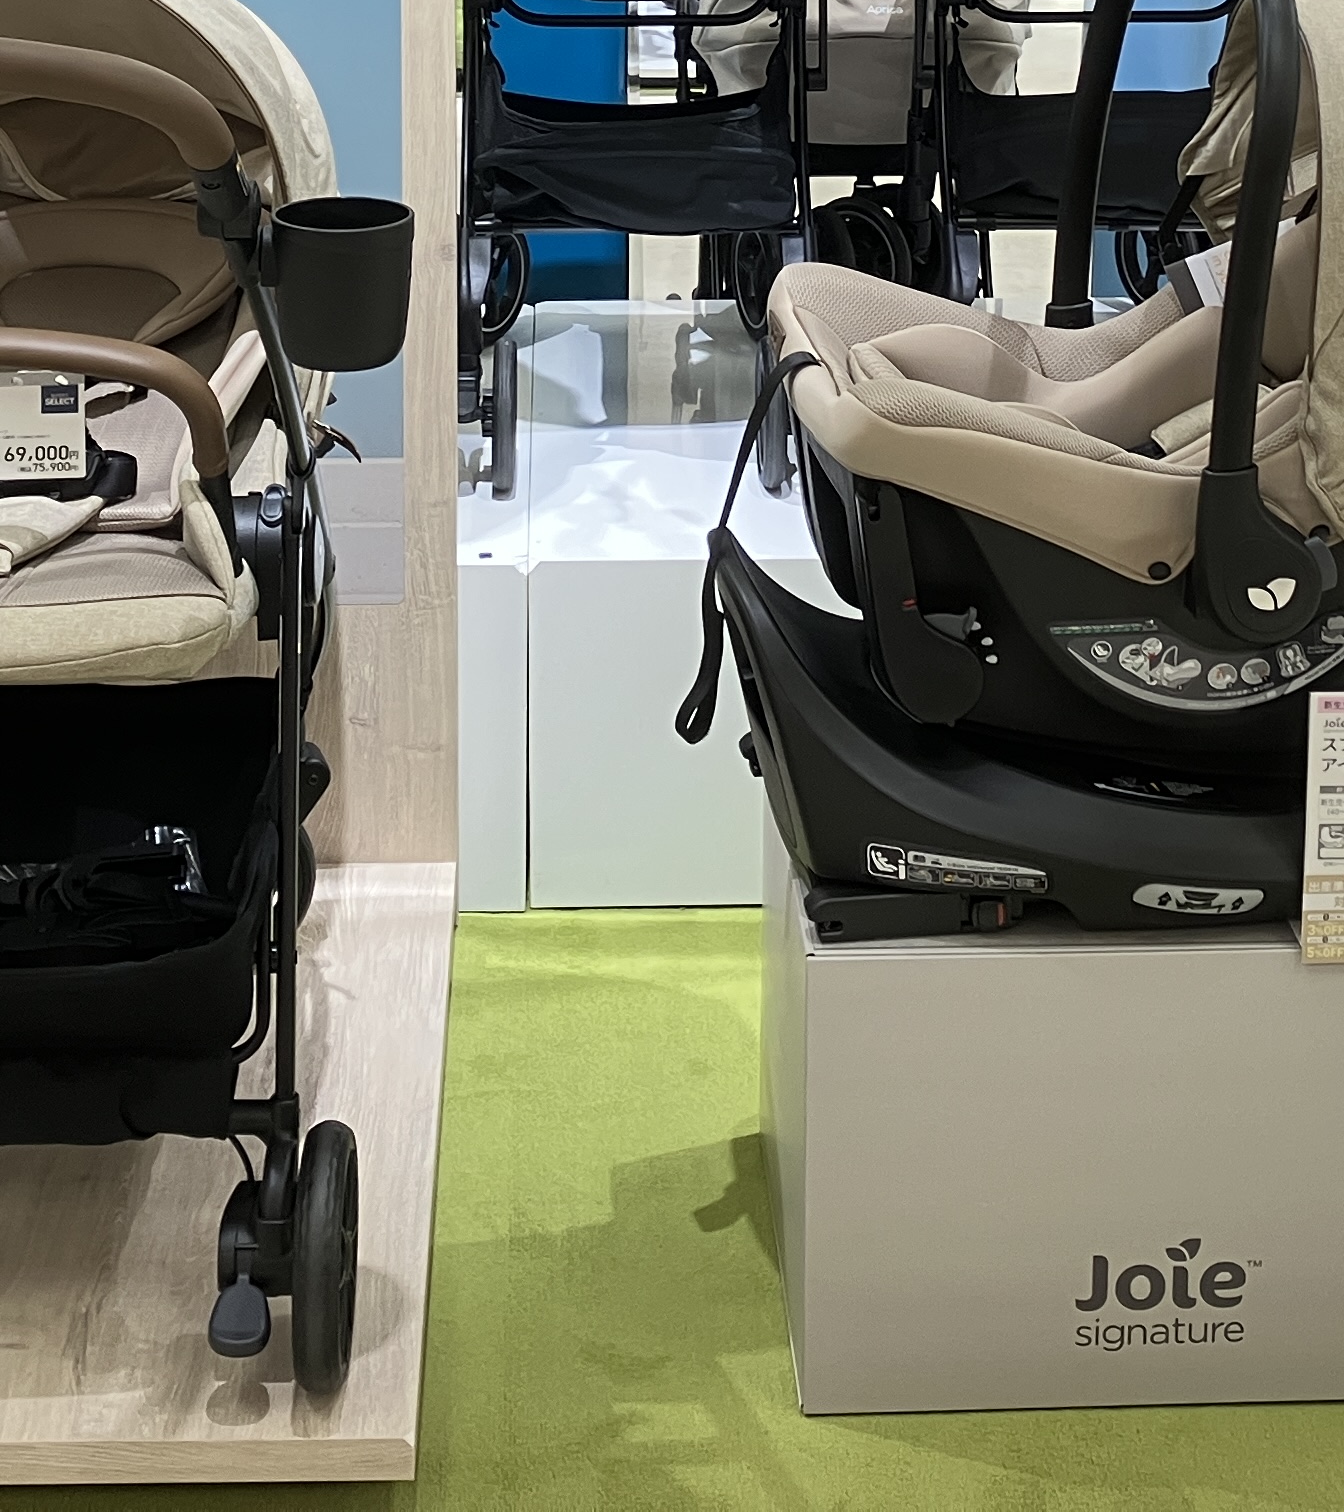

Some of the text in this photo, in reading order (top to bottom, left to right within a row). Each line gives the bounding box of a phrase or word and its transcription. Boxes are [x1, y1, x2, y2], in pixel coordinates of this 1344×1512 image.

[45, 396, 75, 406] SELECT
[4, 445, 79, 462] 69,000円
[1075, 1238, 1246, 1312] Joie
[1075, 1318, 1245, 1352] signature
